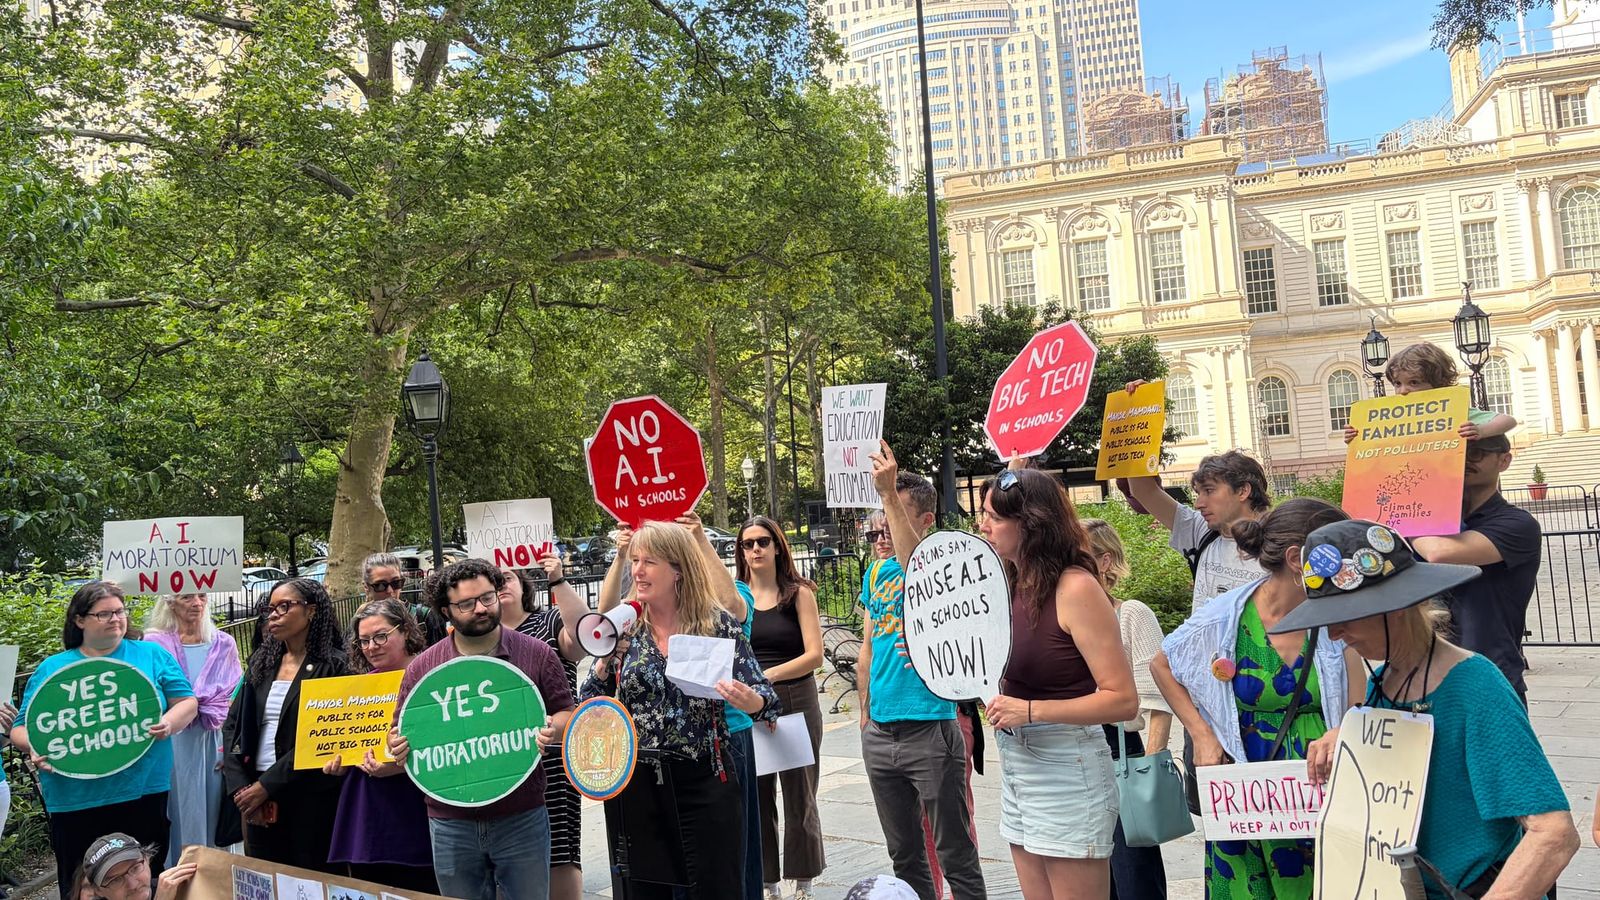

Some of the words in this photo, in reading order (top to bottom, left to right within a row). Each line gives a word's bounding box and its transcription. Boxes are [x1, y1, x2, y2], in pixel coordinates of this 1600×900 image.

[1026, 338, 1064, 373] NO
[831, 390, 846, 409] WE
[849, 388, 874, 407] WANT
[996, 378, 1031, 413] BIG
[1040, 360, 1088, 399] TECH
[998, 421, 1010, 435] IN
[1013, 408, 1064, 433] SCHOOLS
[1368, 398, 1450, 423] PROTECT
[613, 410, 661, 451] NO
[827, 409, 882, 442] EDUCATION
[1109, 425, 1128, 435] PUBLIC
[1136, 421, 1149, 430] FOR
[1362, 417, 1453, 441] FAMILIES!
[1105, 440, 1124, 449] PUBLIC
[1118, 452, 1129, 461] BIG
[1130, 450, 1145, 460] TECH
[1355, 447, 1383, 460] NOT
[1383, 439, 1460, 456] POLLUTERS
[615, 446, 676, 490] A.I.
[842, 446, 858, 468] NOT
[615, 495, 629, 509] IN
[637, 487, 687, 507] SCHOOLS
[827, 471, 880, 504] AUTOMATI
[1382, 501, 1423, 512] climate
[1389, 508, 1432, 520] families
[1385, 518, 1401, 527] nyc
[469, 522, 553, 553] MORATORIUM
[948, 539, 972, 555] SAY:
[106, 547, 238, 571] MORATORIUM
[138, 569, 218, 593] NOW
[907, 563, 956, 610] PAUSE
[960, 553, 993, 587] A.I.
[912, 618, 925, 636] IN
[931, 593, 990, 629] SCHOOLS
[927, 635, 989, 686] NOW!
[60, 671, 118, 702] YES
[305, 698, 344, 711] MAYOR
[429, 679, 500, 722] YES
[36, 693, 138, 733] GREEN
[316, 712, 353, 724] PUBLIC
[367, 709, 385, 719] FOR
[47, 718, 153, 760] SCHOOLS
[309, 727, 346, 738] PUBLIC
[348, 722, 389, 735] SCHOOLS,
[1362, 713, 1396, 749] WE
[316, 741, 337, 751] NOT
[339, 740, 358, 750] BIG
[360, 737, 382, 748] TECH
[412, 726, 539, 776] MORATORIUM
[1229, 820, 1263, 834] KEEP
[1269, 821, 1284, 833] AI
[1289, 820, 1310, 832] OUT
